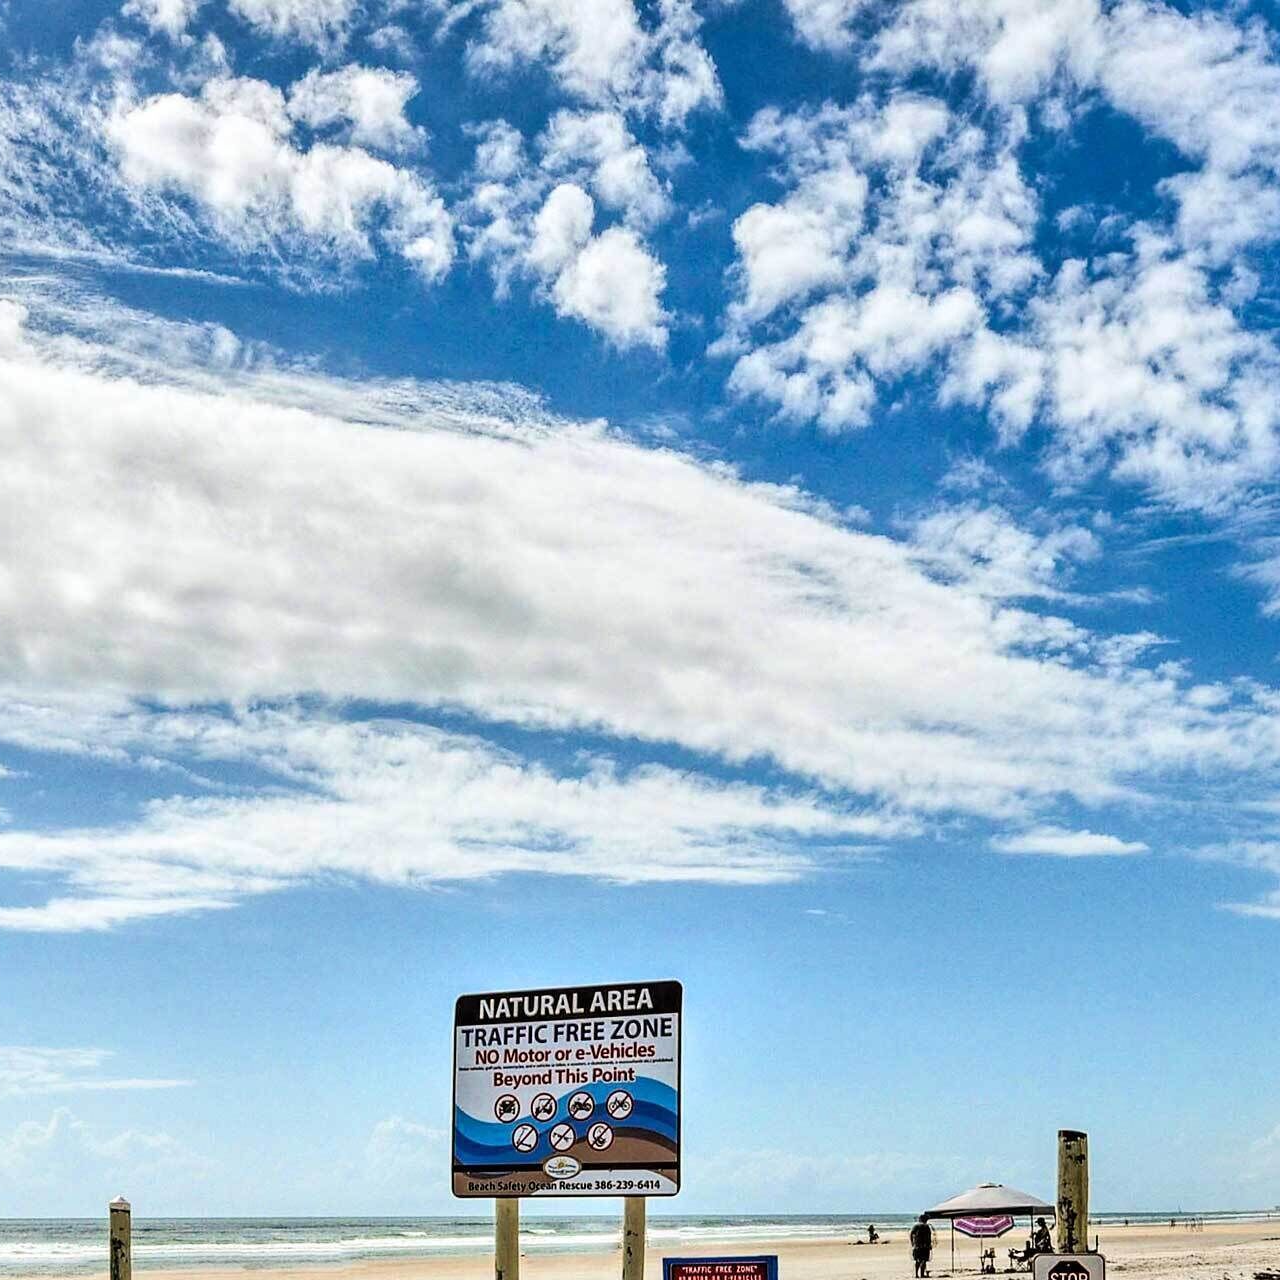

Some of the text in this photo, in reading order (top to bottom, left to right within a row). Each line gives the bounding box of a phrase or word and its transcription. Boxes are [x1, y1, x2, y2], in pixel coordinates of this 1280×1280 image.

[479, 988, 654, 1020] NATURAL AREA
[461, 1017, 673, 1047] TRAFFIC FREE ZONE
[475, 1042, 656, 1065] NO Motor or e-Vehicles
[493, 1067, 635, 1089] Beyond This Point
[468, 1179, 661, 1193] Beach Safety Ocean Rescue 386-239-6414
[715, 1265, 733, 1273] FREE
